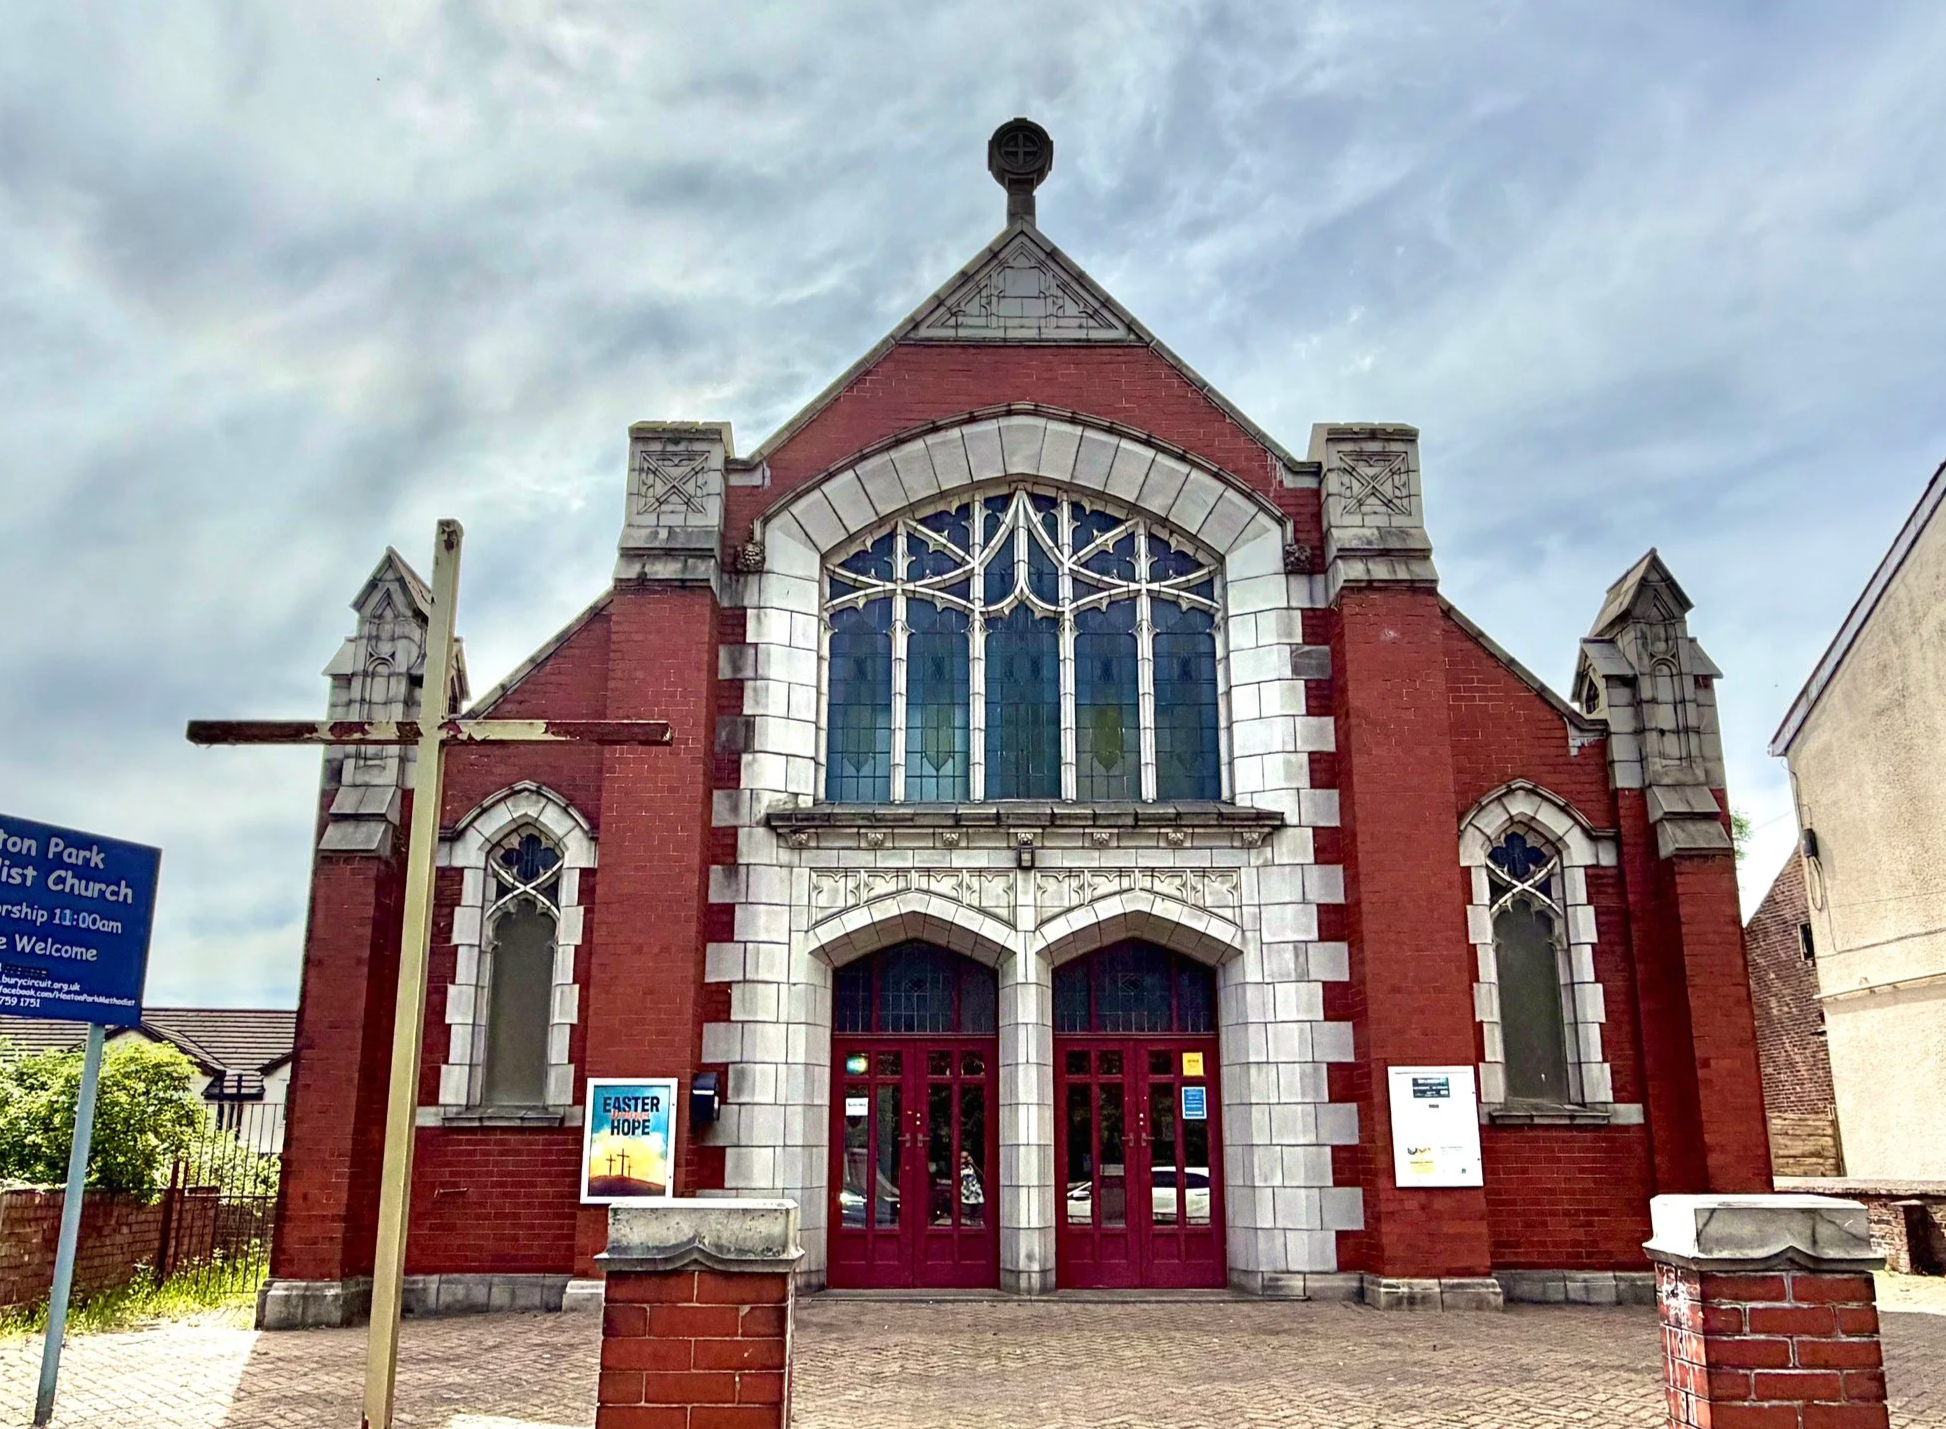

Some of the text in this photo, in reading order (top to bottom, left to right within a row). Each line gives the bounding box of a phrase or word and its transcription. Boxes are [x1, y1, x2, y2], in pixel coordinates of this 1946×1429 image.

[48, 837, 105, 869] Park
[0, 857, 133, 904] ist Church
[53, 908, 122, 934] 11:00am
[15, 933, 98, 962] Welcome
[20, 998, 40, 1007] 1751
[603, 1096, 660, 1112] EASTER
[611, 1119, 650, 1135] HOPE
